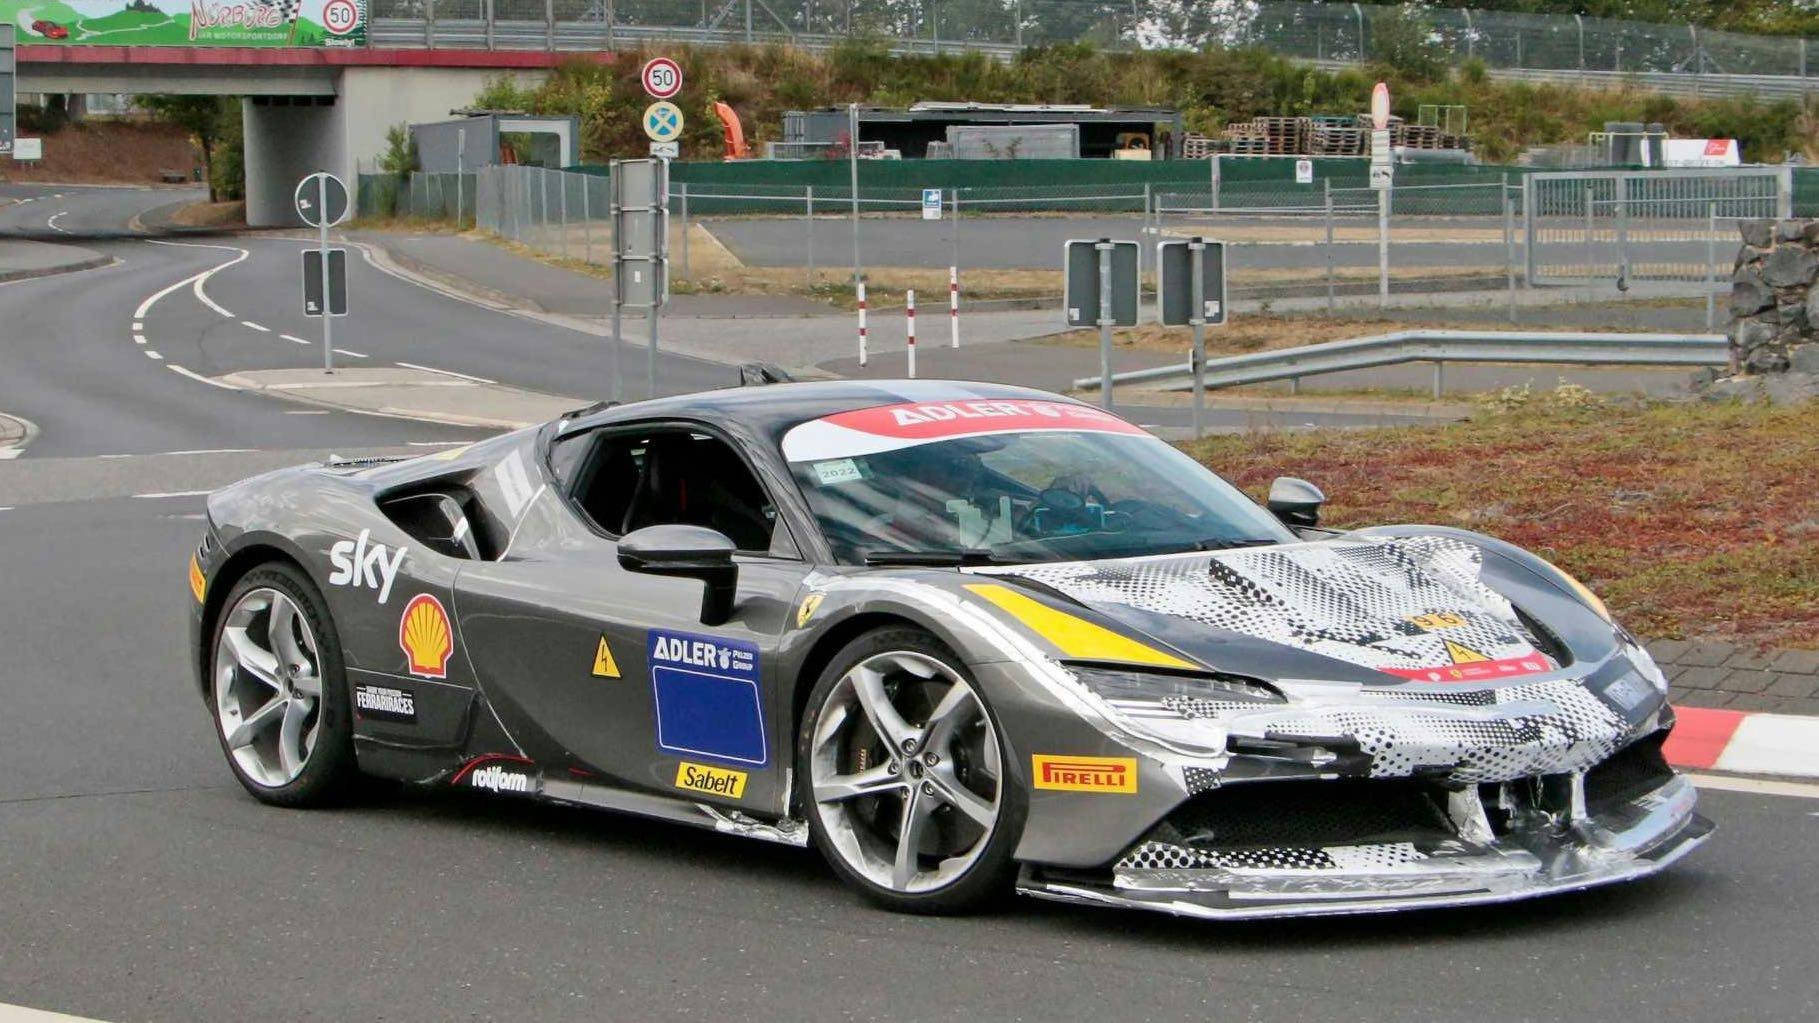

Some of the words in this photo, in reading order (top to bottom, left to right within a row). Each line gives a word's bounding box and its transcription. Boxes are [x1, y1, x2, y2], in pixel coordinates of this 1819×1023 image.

[330, 7, 350, 23] 50
[652, 69, 674, 87] 50
[889, 401, 1033, 427] ADLER
[822, 467, 857, 479] 2022
[328, 527, 409, 605] sky
[653, 636, 717, 668] ADLER
[472, 766, 528, 793] rotiform
[684, 766, 738, 795] Sabelt
[1042, 761, 1127, 787] PIRELLI
